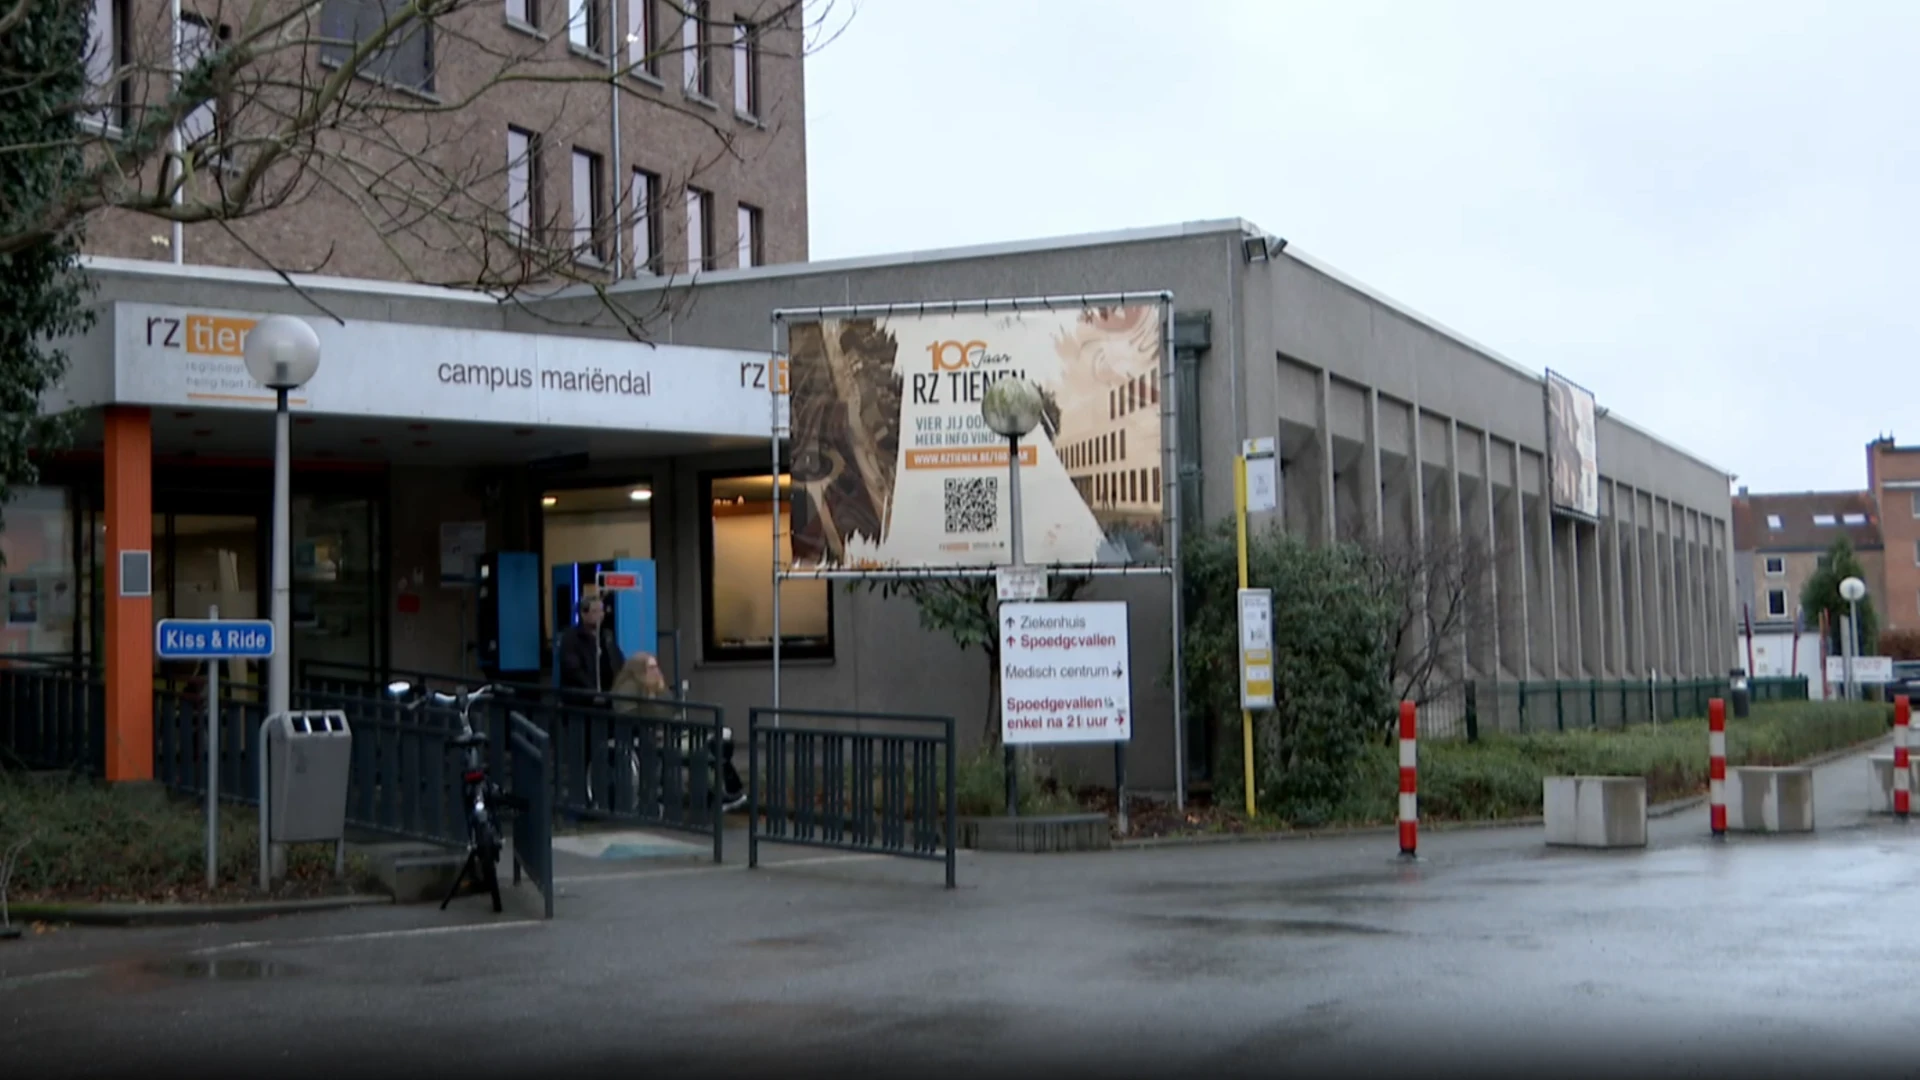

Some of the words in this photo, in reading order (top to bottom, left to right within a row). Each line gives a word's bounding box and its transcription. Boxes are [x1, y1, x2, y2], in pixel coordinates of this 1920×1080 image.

[147, 315, 180, 348] rz
[437, 361, 533, 392] campus
[541, 366, 652, 397] mariëndal
[740, 361, 766, 389] rz
[913, 372, 940, 405] RZ
[915, 416, 942, 432] VIER
[946, 416, 963, 430] JIJ
[915, 433, 942, 446] MEER
[945, 432, 968, 446] INFO
[971, 431, 995, 445] VIND
[1020, 615, 1087, 630] Ziekenhuis
[166, 630, 206, 648] Kiss
[211, 630, 222, 648] &
[227, 630, 266, 648] Ride
[1006, 665, 1057, 680] Medisch
[1060, 665, 1109, 679] centrum
[1007, 697, 1103, 713] Spoedgevallen
[1007, 716, 1042, 730] enkel
[1047, 718, 1063, 729] na
[1066, 714, 1081, 728] 21
[1087, 716, 1108, 728] uur
